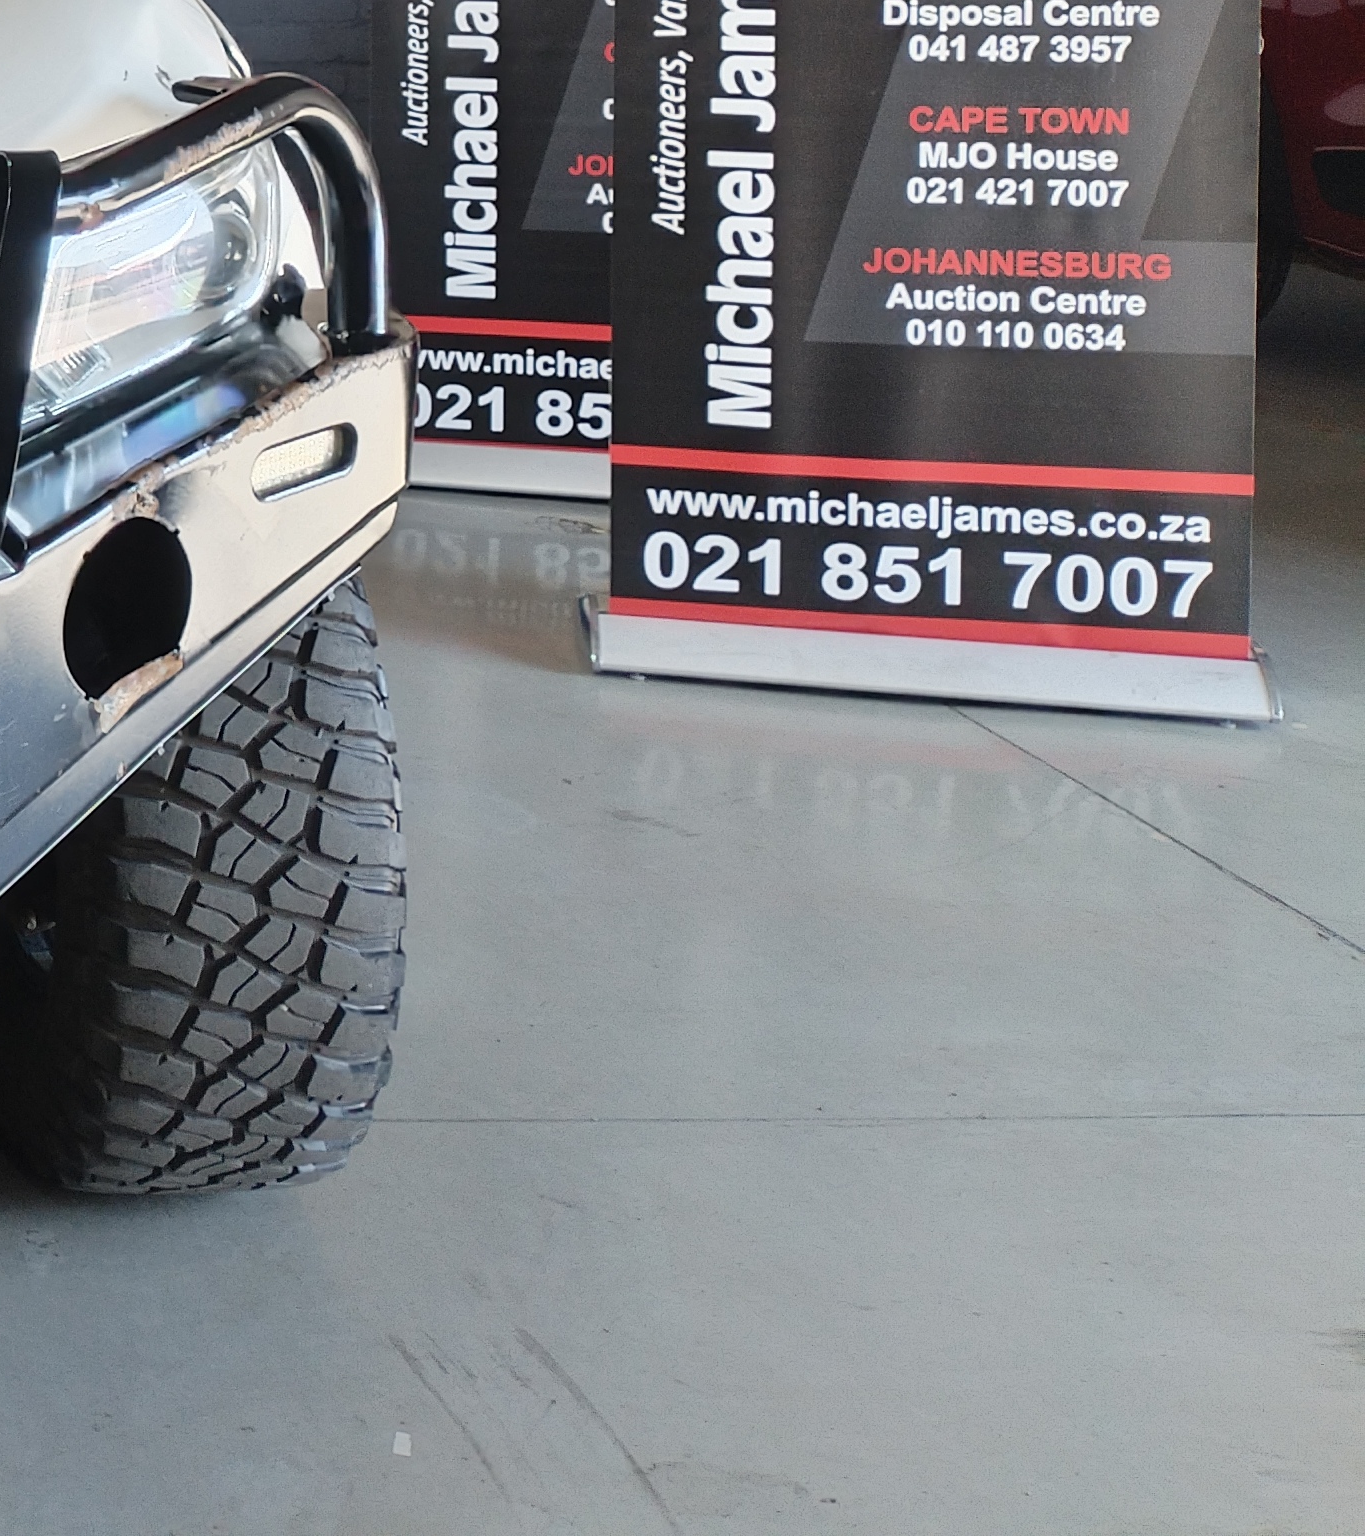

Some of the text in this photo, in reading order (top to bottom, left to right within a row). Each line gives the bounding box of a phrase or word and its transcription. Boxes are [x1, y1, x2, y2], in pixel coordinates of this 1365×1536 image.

[908, 33, 1133, 64] 041 487 3957
[908, 105, 1130, 135] CAPE TOWN
[649, 49, 694, 236] Auctioneers,
[918, 140, 1119, 172] MJO House
[443, 76, 499, 300] Michael
[906, 176, 1130, 208] 021 421 7007
[862, 247, 1172, 281] JOHANNESBURG
[704, 149, 776, 429] Michael
[885, 282, 1147, 317] Auction Centre
[905, 318, 1127, 352] 010 110 0634
[419, 348, 612, 380] ww.michae
[535, 389, 612, 439] 85
[646, 486, 1211, 546] www.michaeljames.co.za
[643, 530, 782, 596] 021
[821, 542, 962, 606] 851
[1003, 551, 1214, 619] 7007
